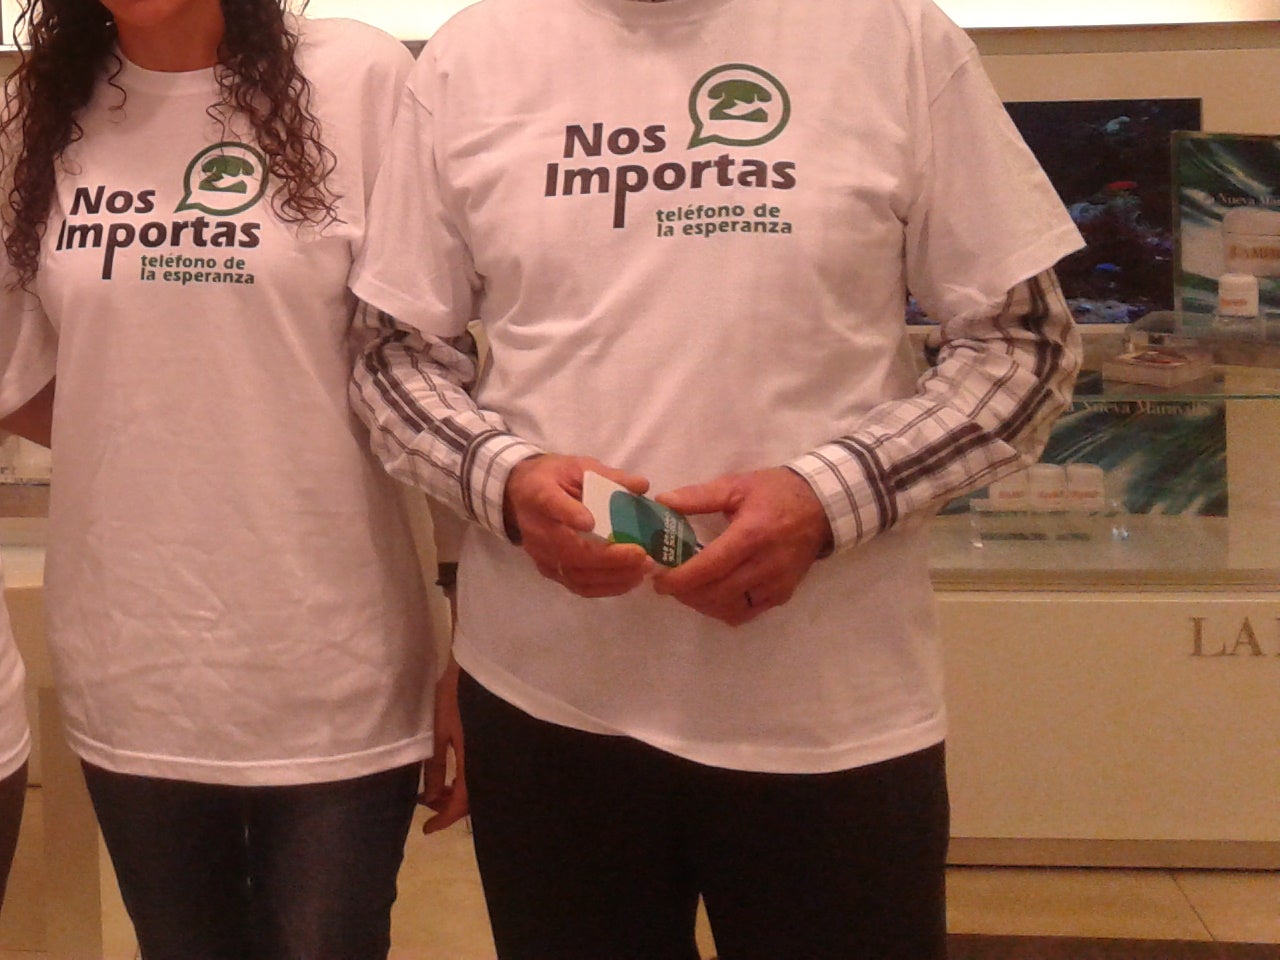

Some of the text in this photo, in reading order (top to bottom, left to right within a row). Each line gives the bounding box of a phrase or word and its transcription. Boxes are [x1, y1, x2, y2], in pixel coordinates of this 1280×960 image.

[563, 123, 666, 158] Nos
[70, 186, 156, 215] Nos
[544, 153, 797, 229] Importas
[656, 203, 781, 222] teléfono de
[657, 221, 793, 238] la esperanza
[55, 216, 260, 280] Importas
[141, 253, 246, 270] teléfono de
[140, 267, 255, 285] la esperanza
[1189, 616, 1266, 657] LA
